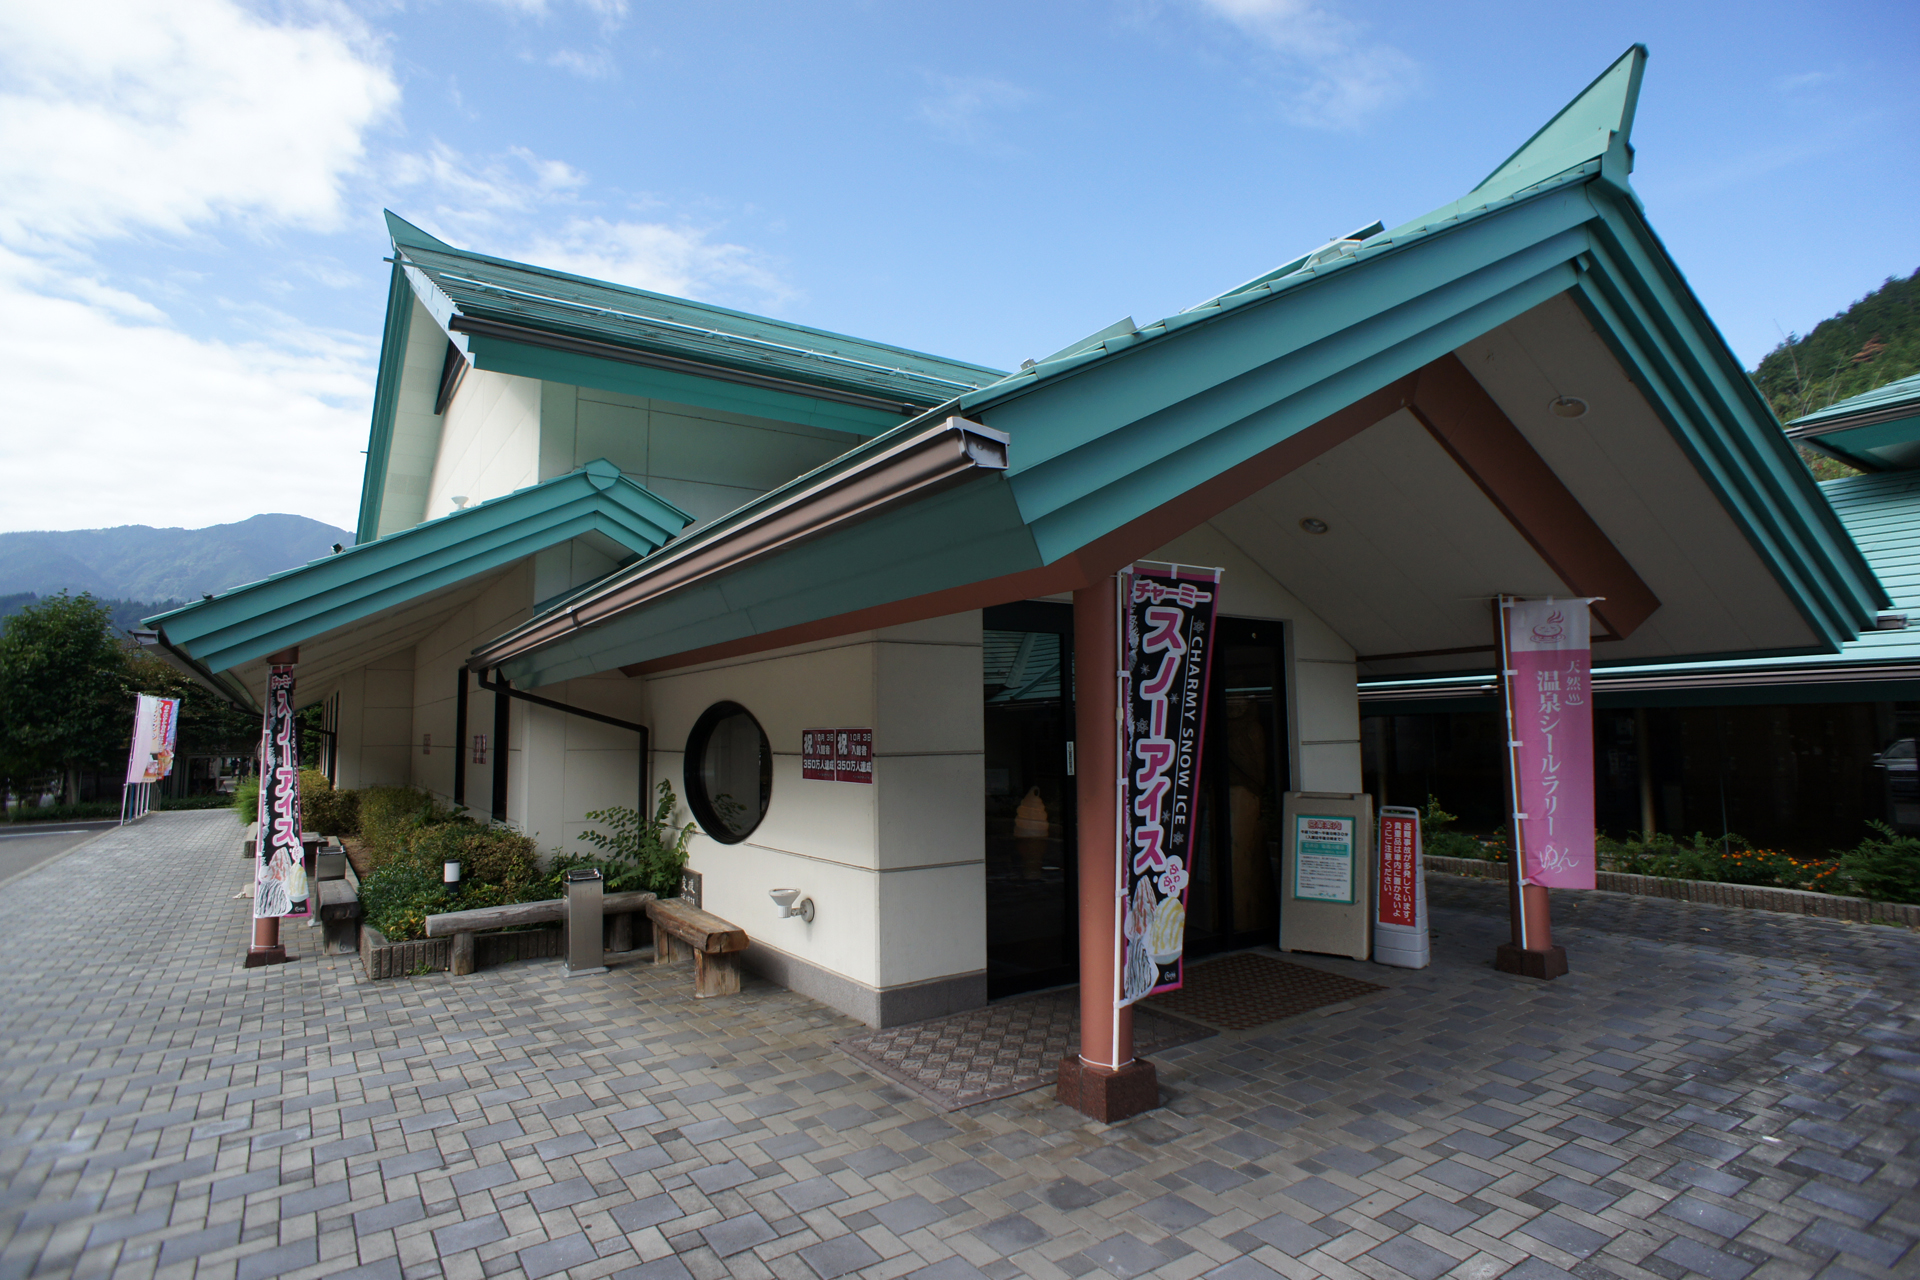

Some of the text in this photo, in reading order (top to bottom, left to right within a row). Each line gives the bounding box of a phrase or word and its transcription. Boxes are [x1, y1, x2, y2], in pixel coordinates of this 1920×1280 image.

[1133, 580, 1212, 608] チャーミー
[1566, 660, 1582, 691] 天然
[803, 733, 814, 755] 祝
[837, 733, 848, 755] 祝
[1135, 606, 1187, 876] スノーアイス
[1174, 636, 1203, 825] CHARMY SNOW ICE
[803, 759, 835, 771] 350万人達成
[816, 744, 831, 755] 入館者
[851, 744, 868, 756] 入館者
[1537, 670, 1561, 836] 温泉シールラリー
[272, 690, 295, 847] スノーアイス
[836, 760, 872, 773] 350万人達成
[1383, 821, 1393, 895] うにご注意ください。
[1393, 821, 1402, 917] 貴重品は車内に置かないよ
[1402, 822, 1412, 922] 盗難事故が多発しています。
